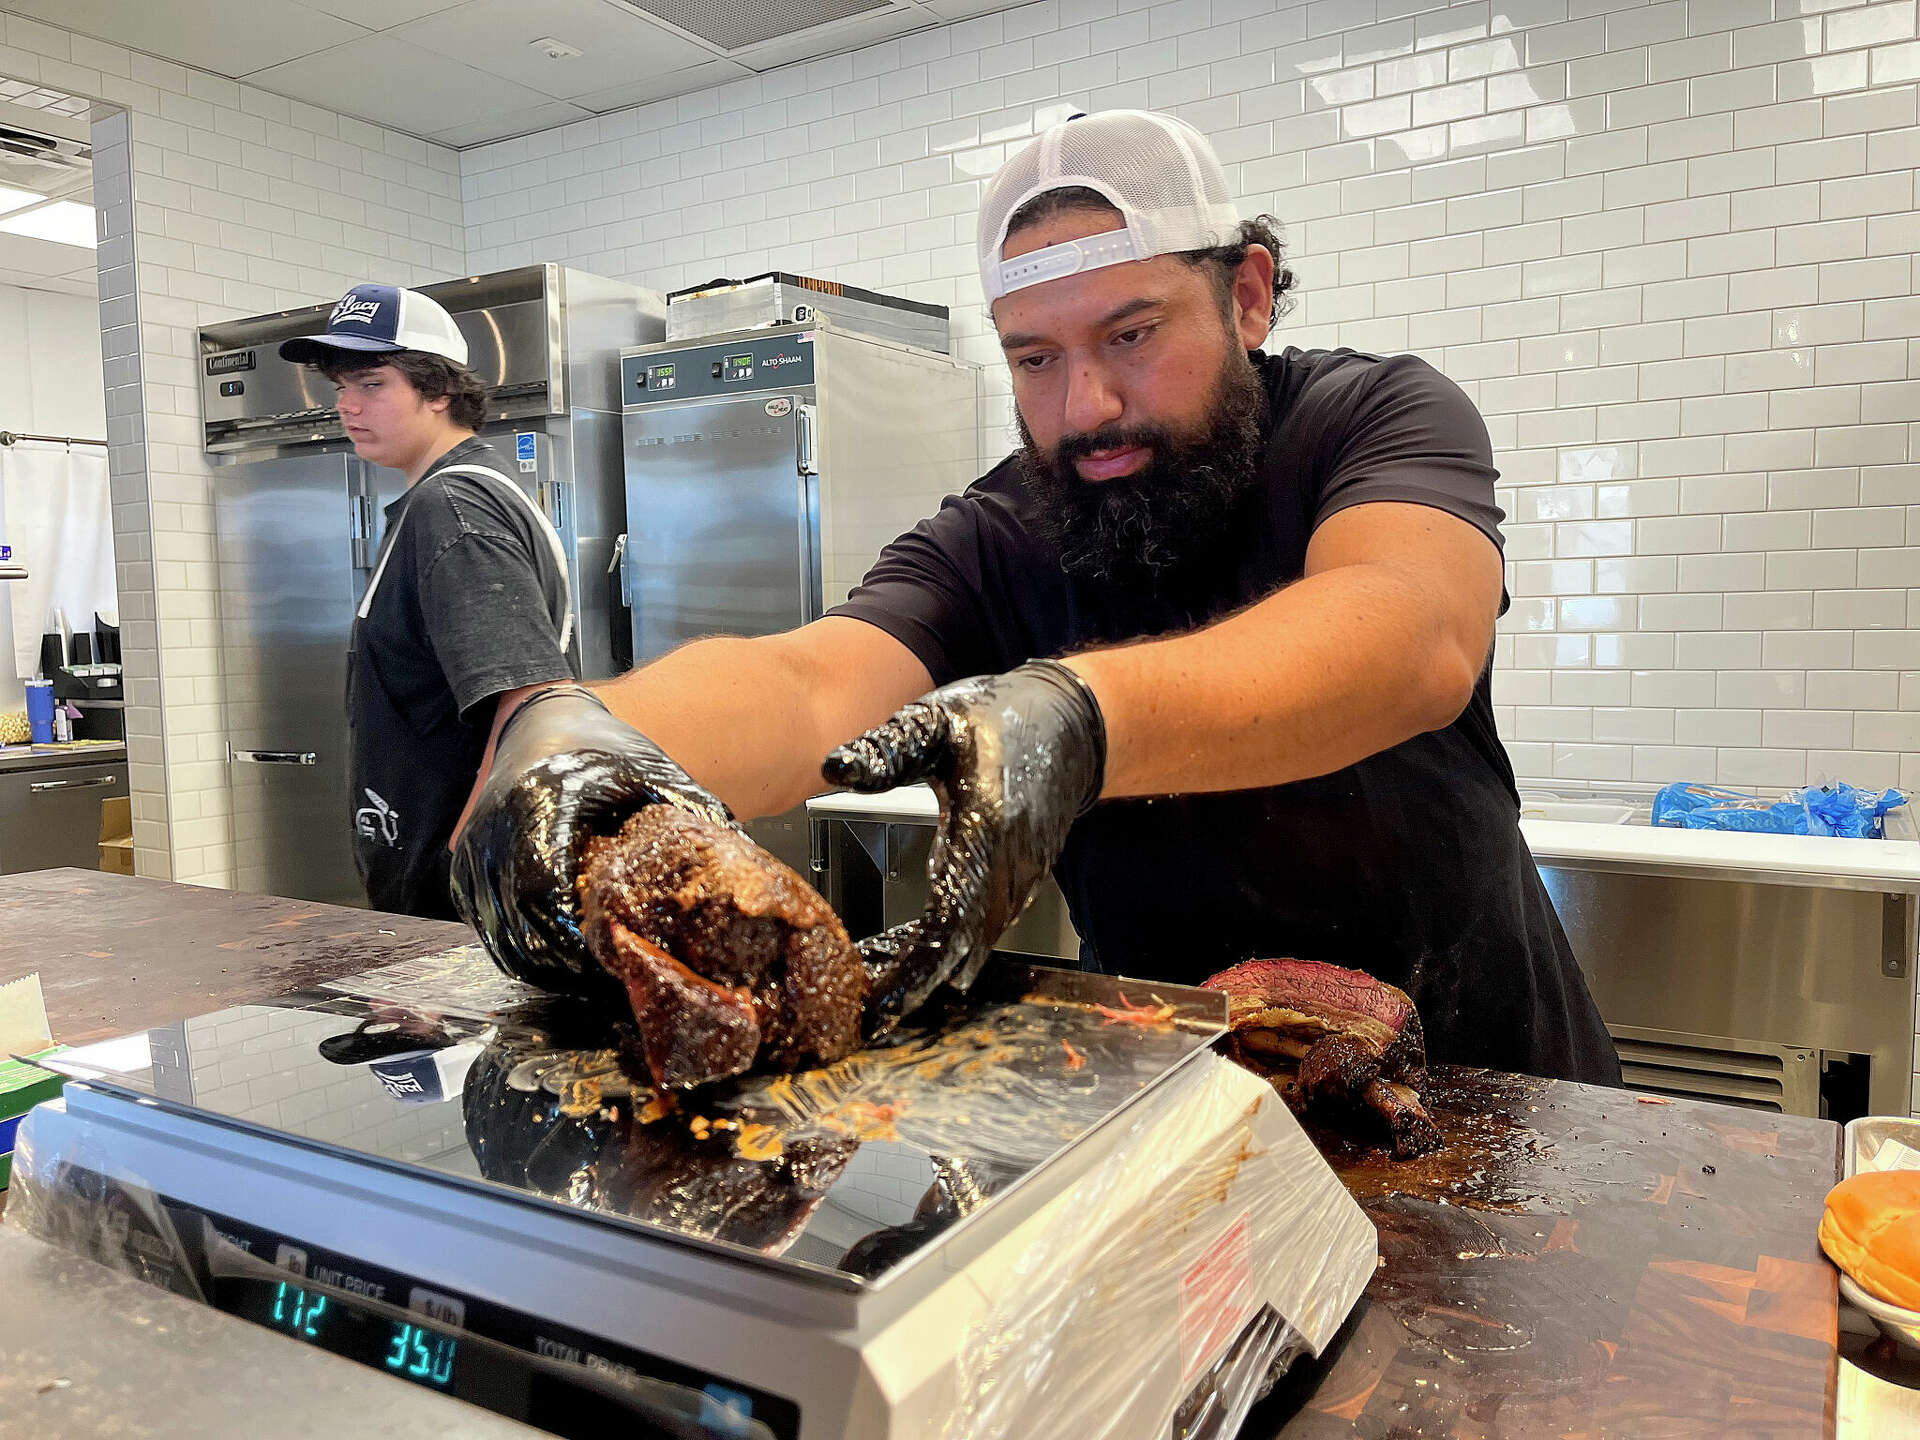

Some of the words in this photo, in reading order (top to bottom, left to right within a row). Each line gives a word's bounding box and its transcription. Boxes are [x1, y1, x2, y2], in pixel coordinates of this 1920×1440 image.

[313, 1264, 343, 1288] UNIT
[345, 1275, 386, 1302] PRICE
[535, 1335, 582, 1366] TOTAL
